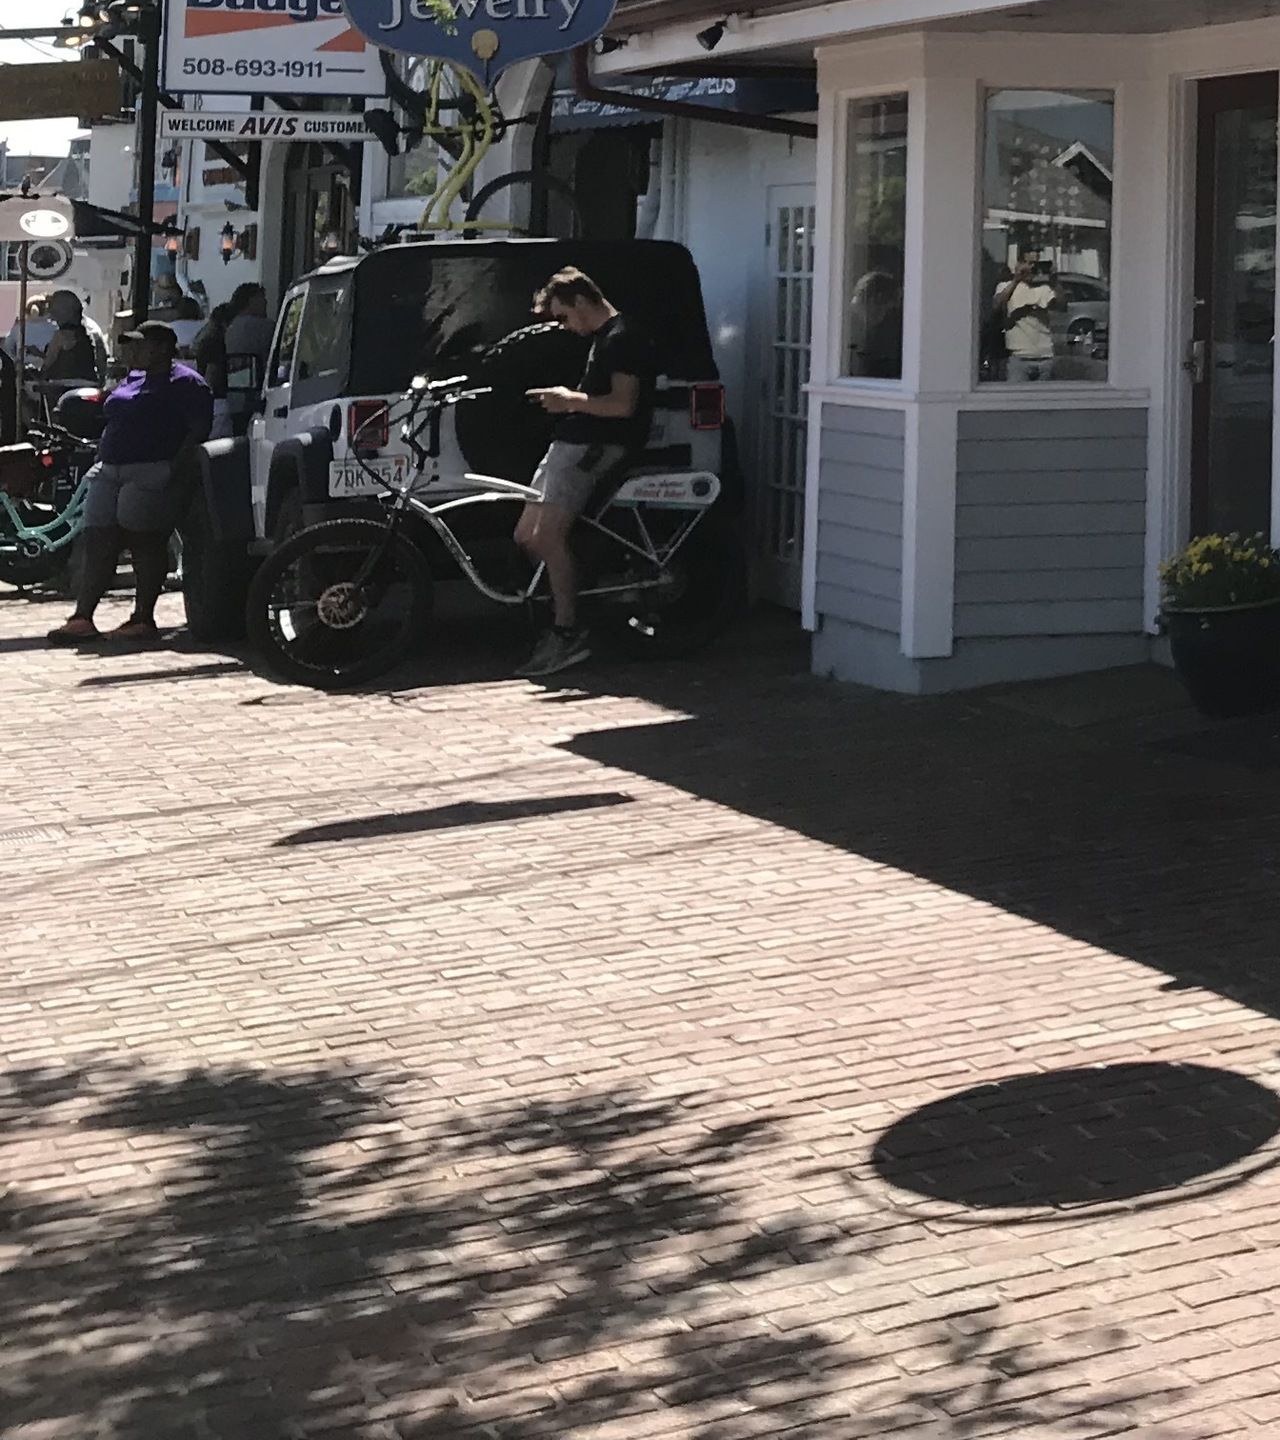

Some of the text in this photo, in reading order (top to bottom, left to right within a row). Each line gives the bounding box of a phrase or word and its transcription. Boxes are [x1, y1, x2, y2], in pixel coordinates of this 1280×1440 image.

[183, 58, 322, 77] 508-693-1911
[168, 117, 372, 135] WELCOME AVIS CUSTOME
